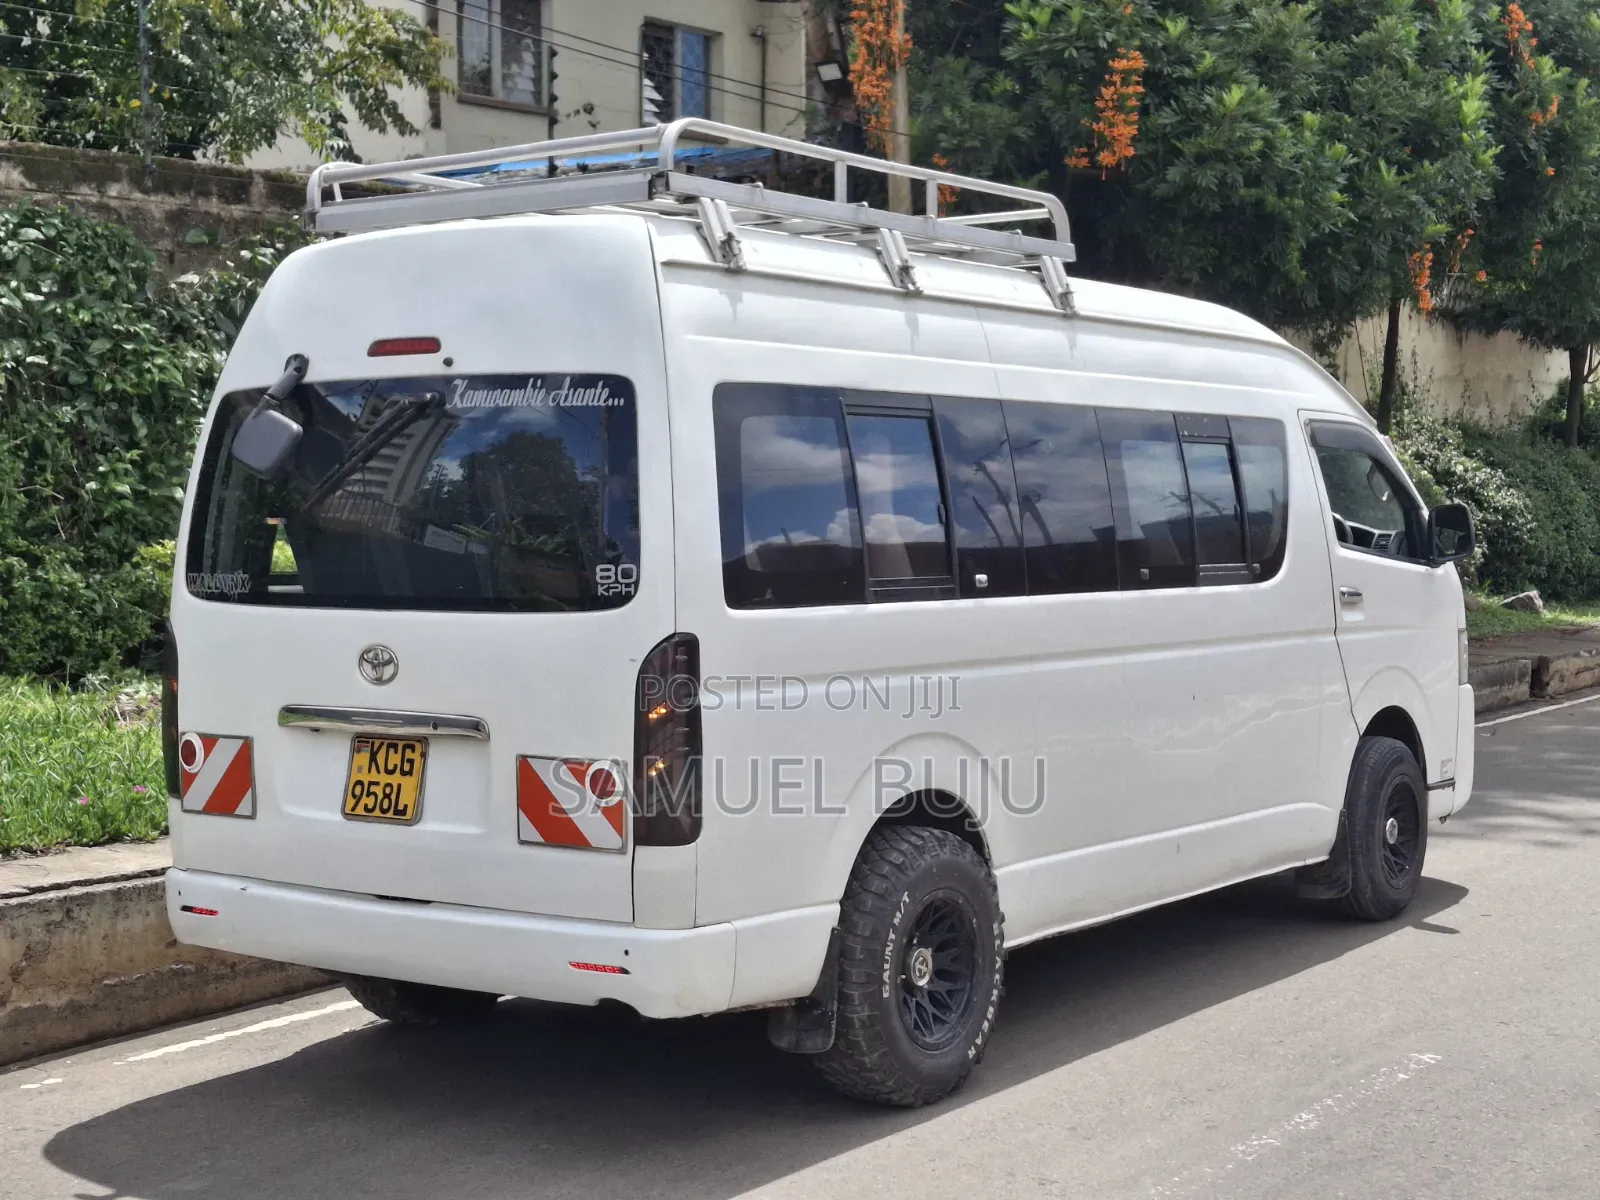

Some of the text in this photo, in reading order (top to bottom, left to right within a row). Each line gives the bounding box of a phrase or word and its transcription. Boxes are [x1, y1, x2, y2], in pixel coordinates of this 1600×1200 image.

[446, 377, 547, 409] Kamwambie
[595, 563, 637, 584] 80
[597, 583, 635, 596] KPH
[368, 740, 416, 777] KCG
[350, 779, 409, 816] 958L
[882, 891, 910, 998] GAUNT M/T
